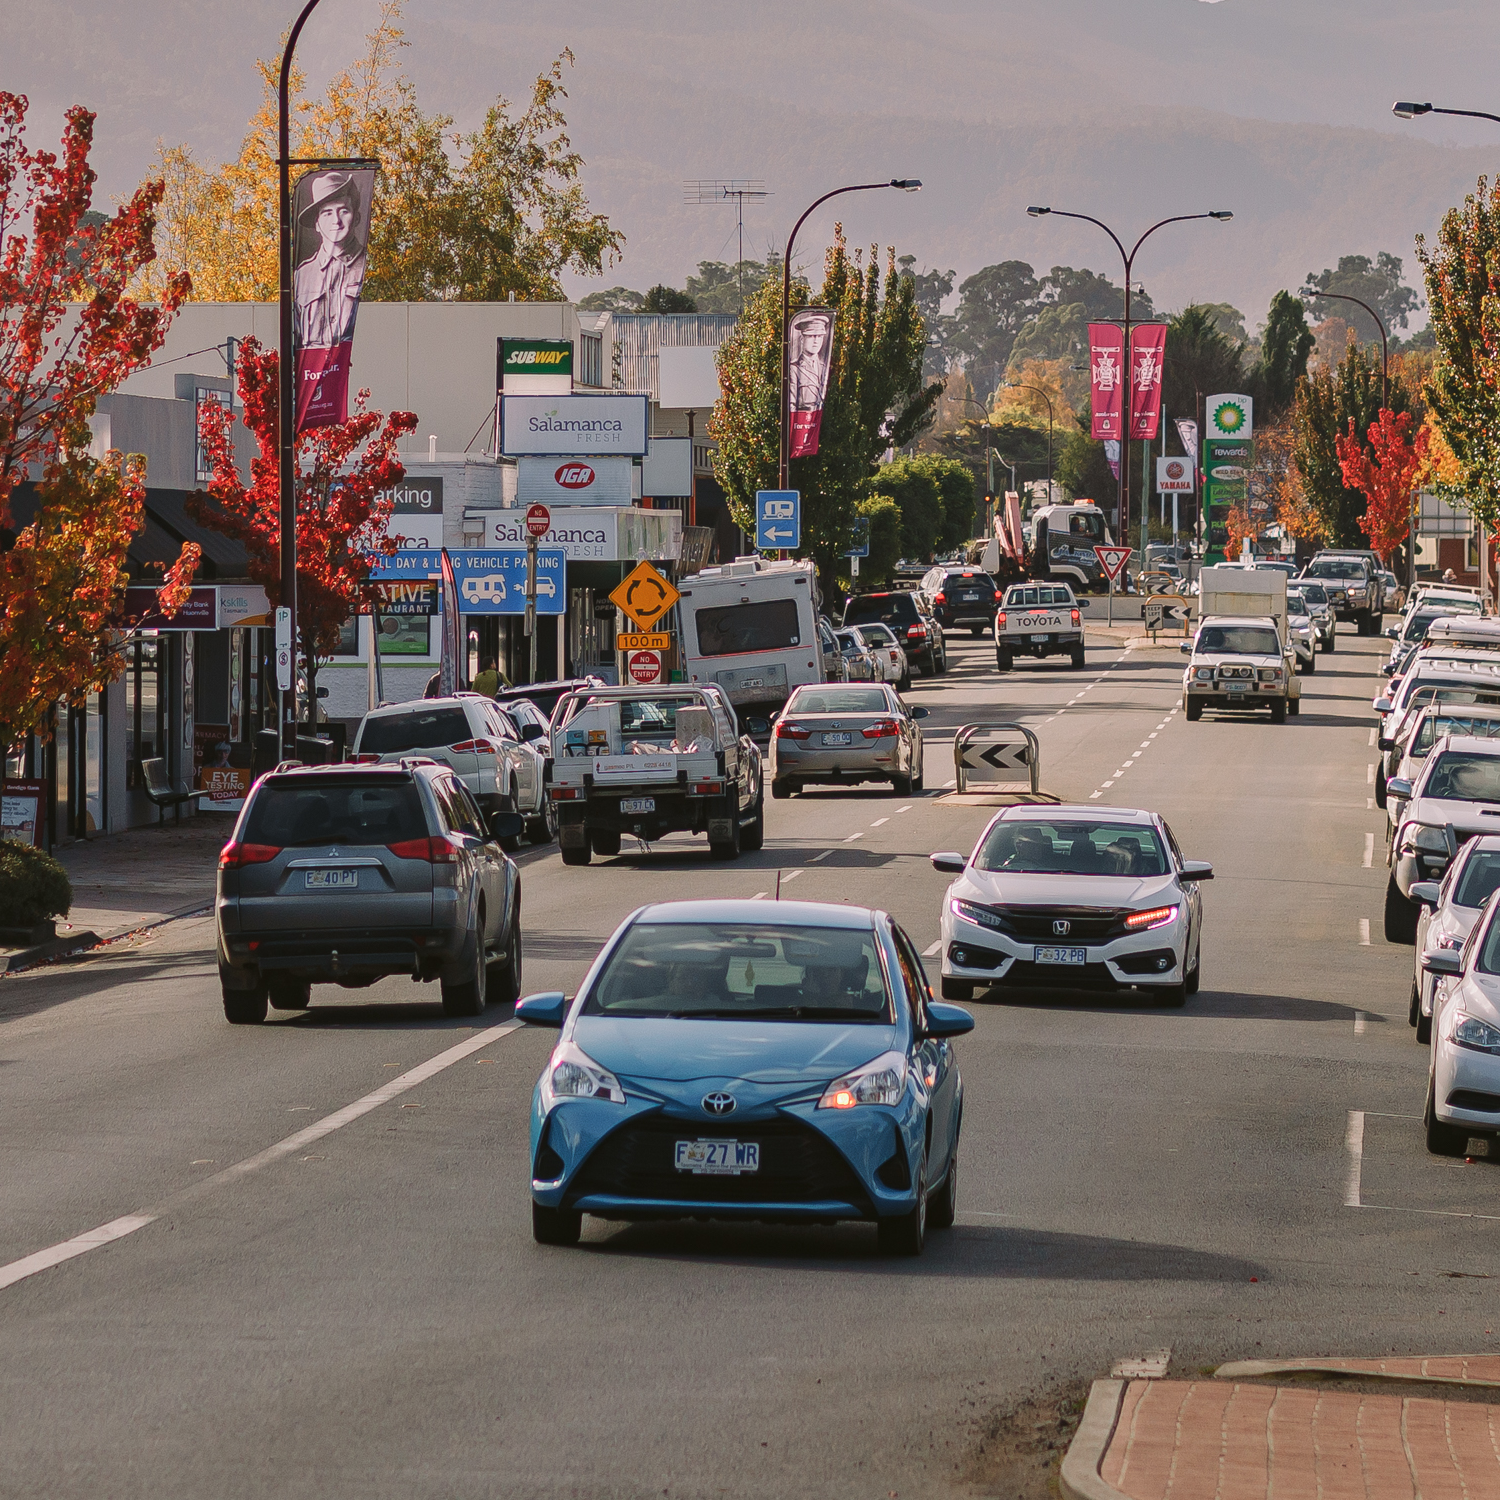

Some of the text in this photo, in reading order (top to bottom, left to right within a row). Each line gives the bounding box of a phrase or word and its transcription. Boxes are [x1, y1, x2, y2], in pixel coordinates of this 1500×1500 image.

[506, 350, 570, 364] SUBWAY
[528, 416, 623, 432] Salamanca
[576, 433, 621, 443] FRESH
[558, 468, 589, 484] IGA
[1159, 481, 1191, 490] YAMAHA
[373, 486, 433, 508] arking
[534, 509, 543, 517] NO
[495, 523, 607, 543] Salmanca
[529, 524, 547, 532] ENTRY
[553, 545, 604, 556] RESH
[396, 557, 417, 569] DAY
[422, 557, 430, 569] &
[433, 557, 461, 569] LNG
[466, 557, 510, 569] VEHICLE
[514, 557, 559, 569] PAKING
[359, 604, 431, 614] RETAURANT
[278, 610, 288, 622] 1P
[1015, 616, 1062, 627] TOYOTA
[623, 636, 664, 647] 100 m
[639, 655, 650, 664] NO
[633, 670, 656, 679] ENTRY
[212, 771, 239, 783] EYE
[205, 781, 245, 790] TESTING
[211, 790, 239, 799] TODAY
[632, 801, 643, 810] 97
[306, 870, 357, 885] E 40 PT
[1036, 948, 1084, 962] F 32 PB
[676, 1143, 758, 1166] F 27 WR
